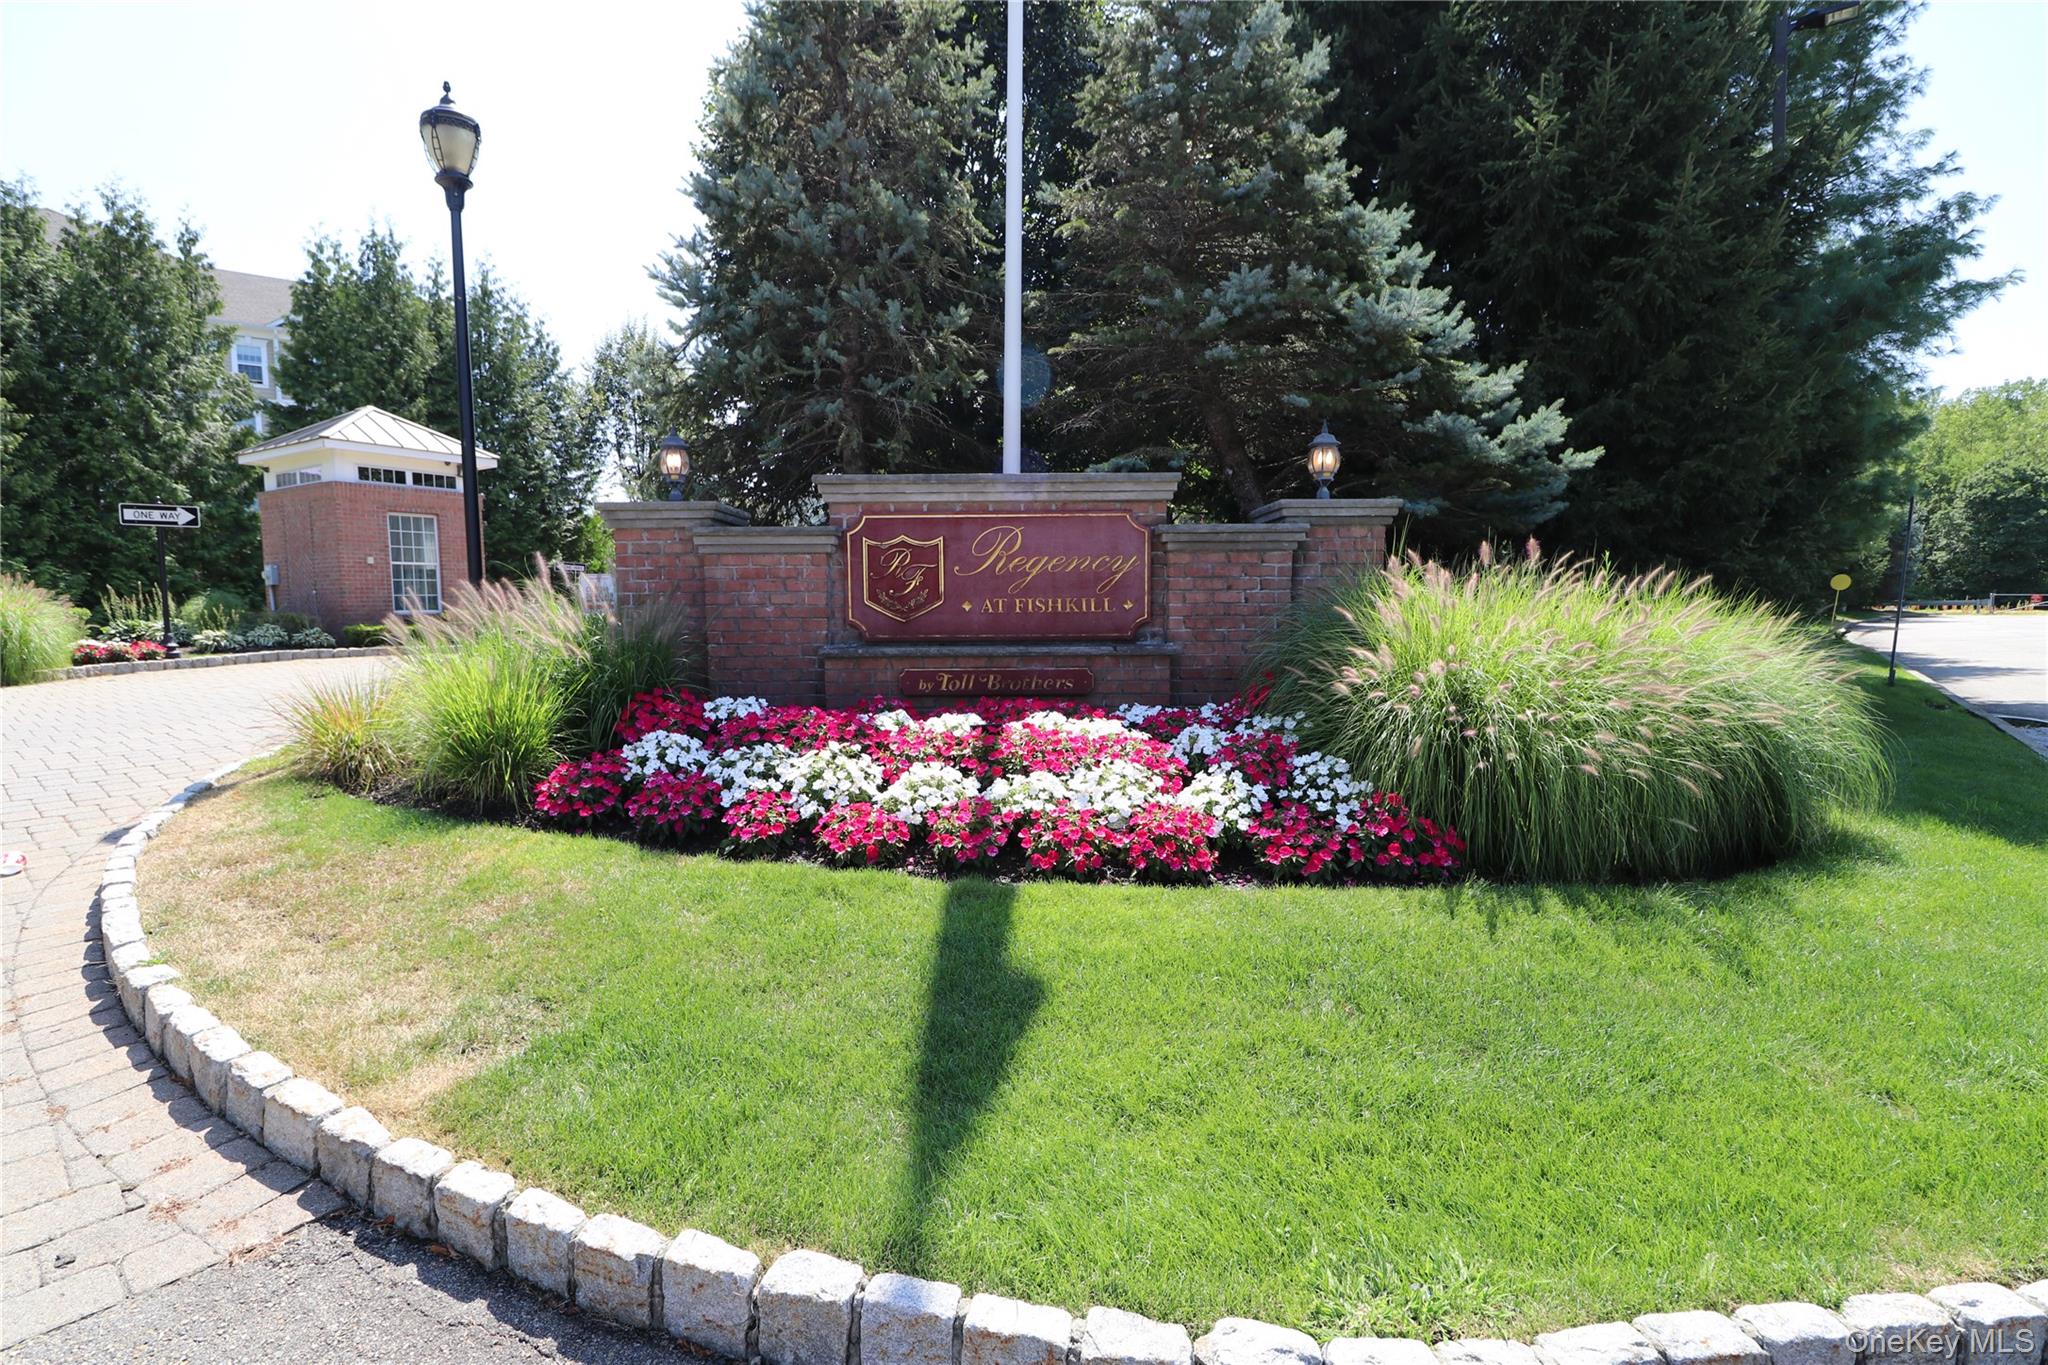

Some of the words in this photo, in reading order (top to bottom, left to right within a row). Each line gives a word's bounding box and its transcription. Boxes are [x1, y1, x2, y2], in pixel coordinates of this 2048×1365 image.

[133, 511, 154, 519] ONE
[160, 512, 181, 520] WAY
[953, 525, 1140, 595] Regency
[981, 599, 1007, 613] AT
[1015, 598, 1116, 613] FISHKILL
[918, 679, 935, 692] by
[936, 673, 975, 691] Toll
[979, 673, 1076, 691] Brothers
